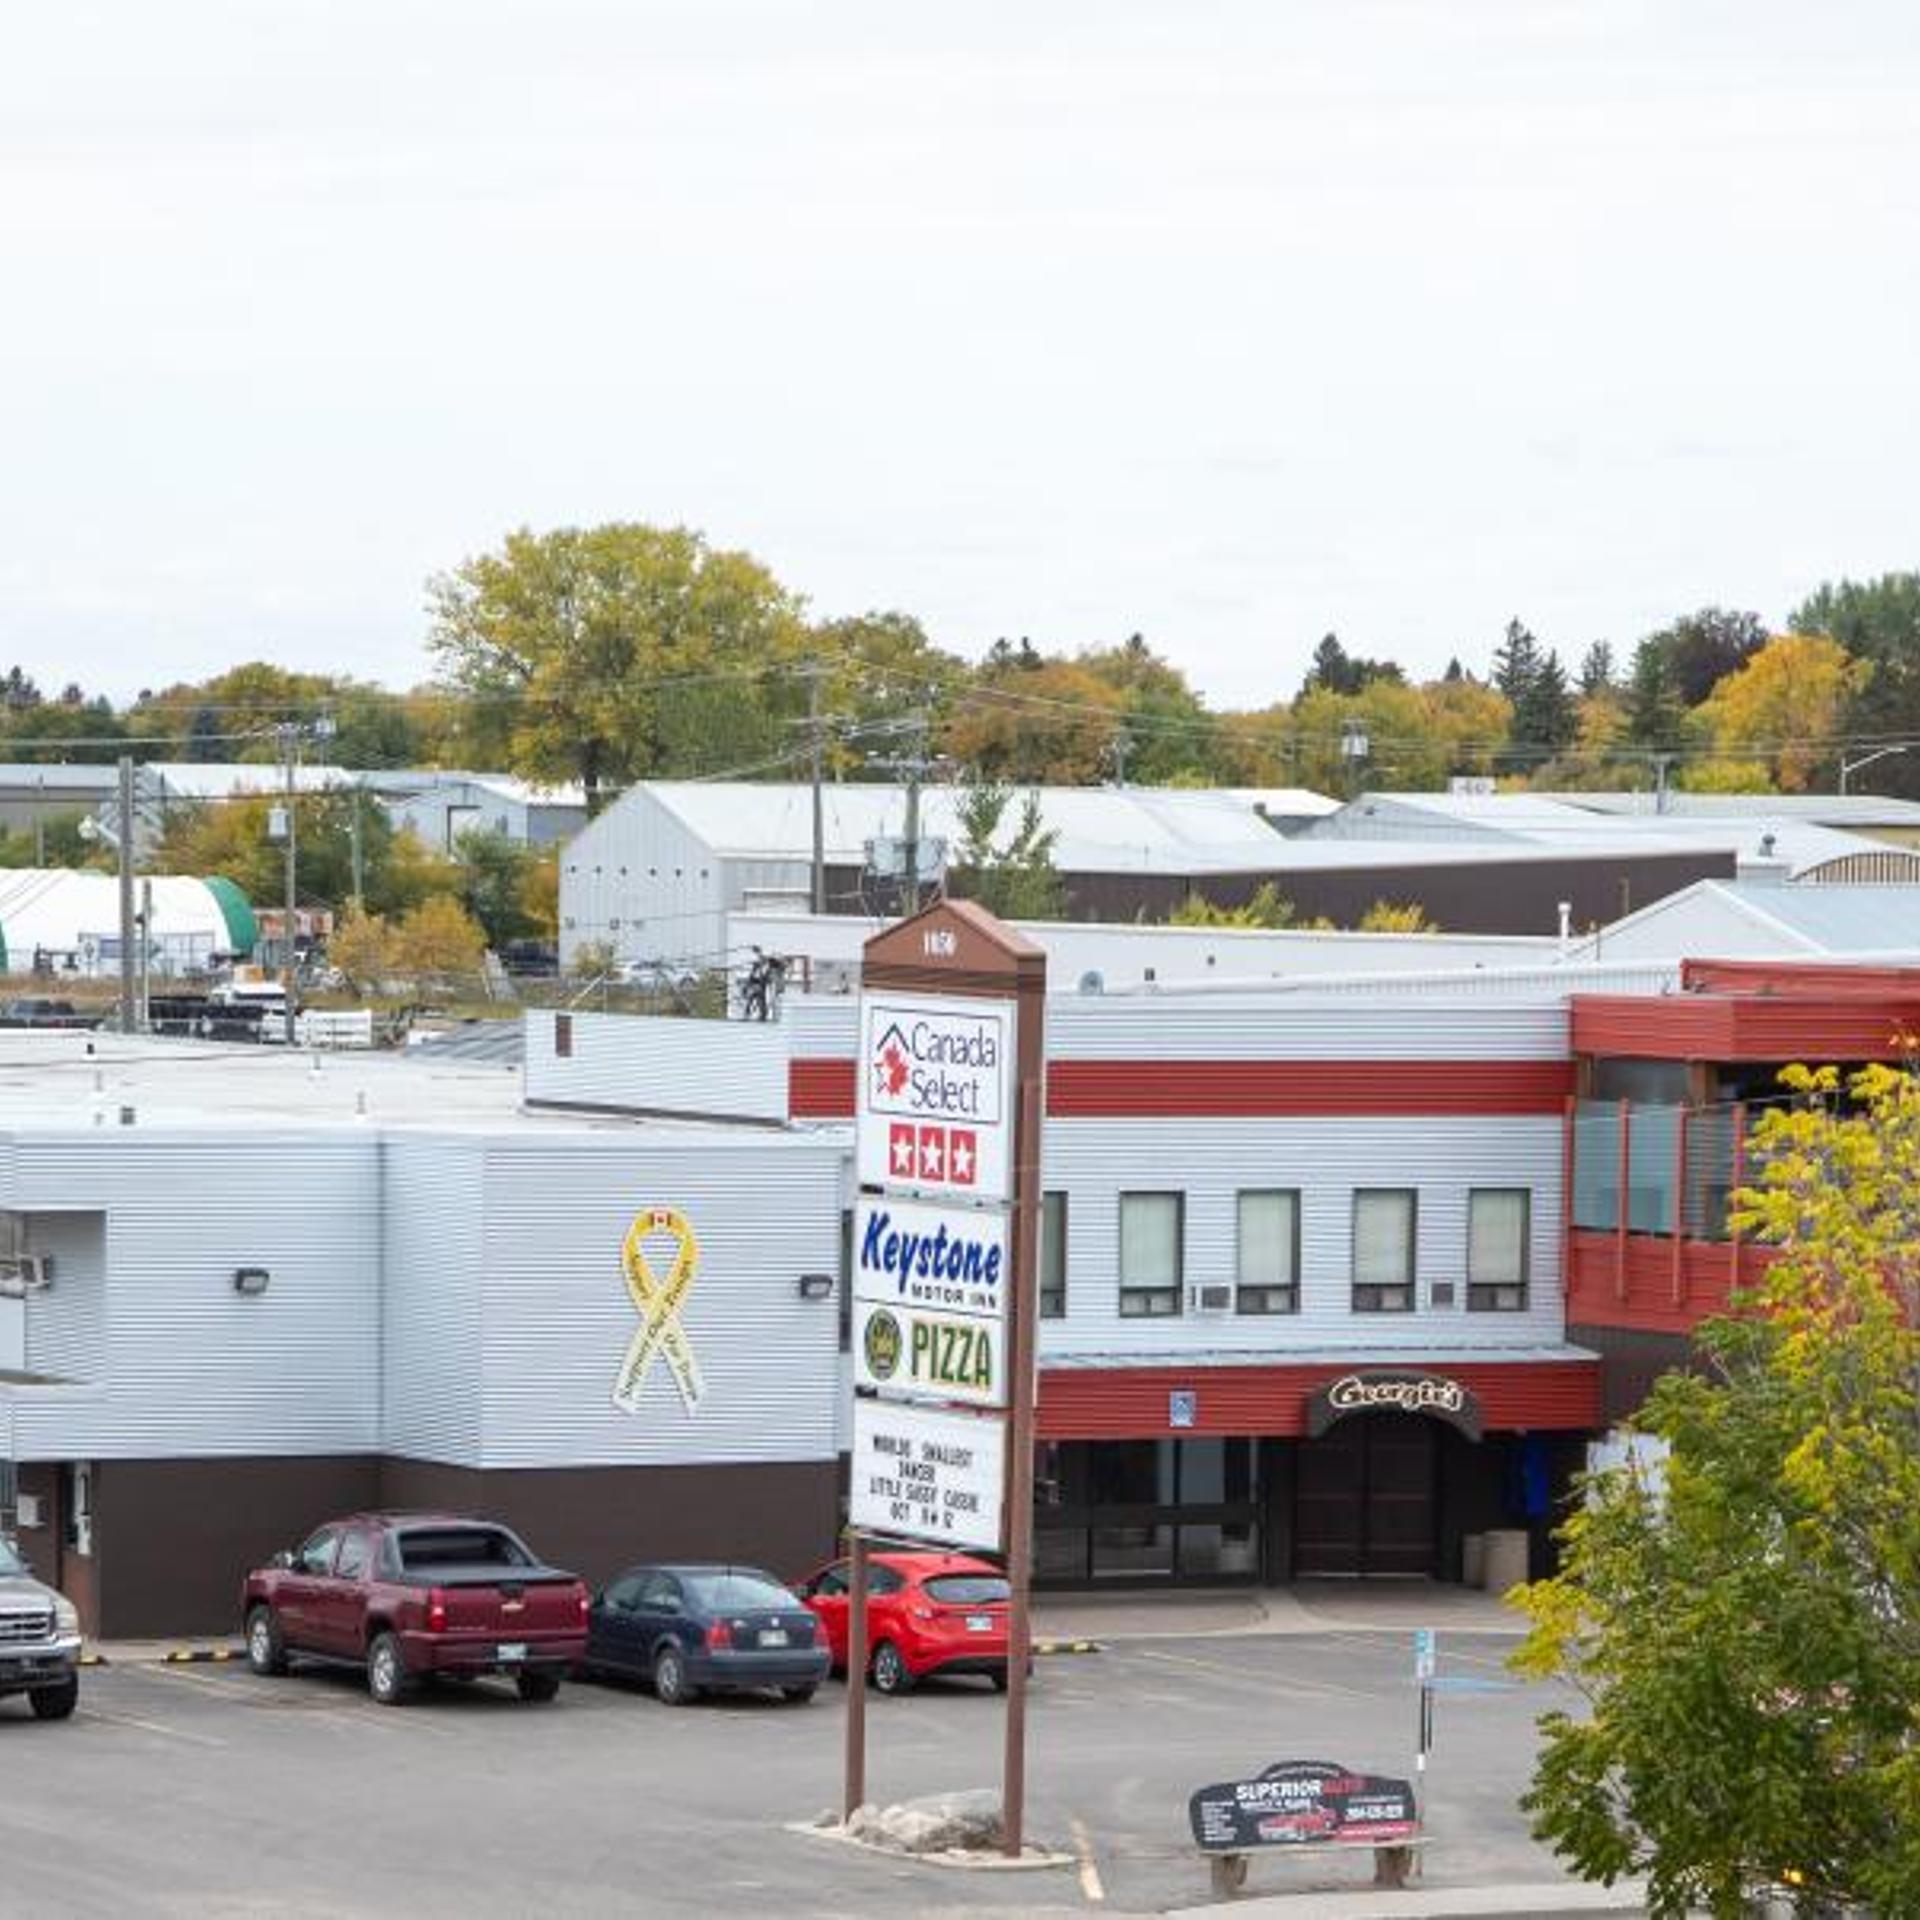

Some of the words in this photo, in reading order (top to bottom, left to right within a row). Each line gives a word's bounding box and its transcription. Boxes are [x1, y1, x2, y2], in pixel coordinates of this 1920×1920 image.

[912, 1021, 997, 1068] Canada
[911, 1069, 979, 1113] Select
[861, 1210, 1001, 1294] Keystone
[912, 1283, 964, 1304] MOTOR
[911, 1321, 992, 1387] PIZZA
[869, 1476, 901, 1499] LITTLE
[890, 1502, 910, 1521] OCT
[1235, 1779, 1322, 1801] SUPERIOR
